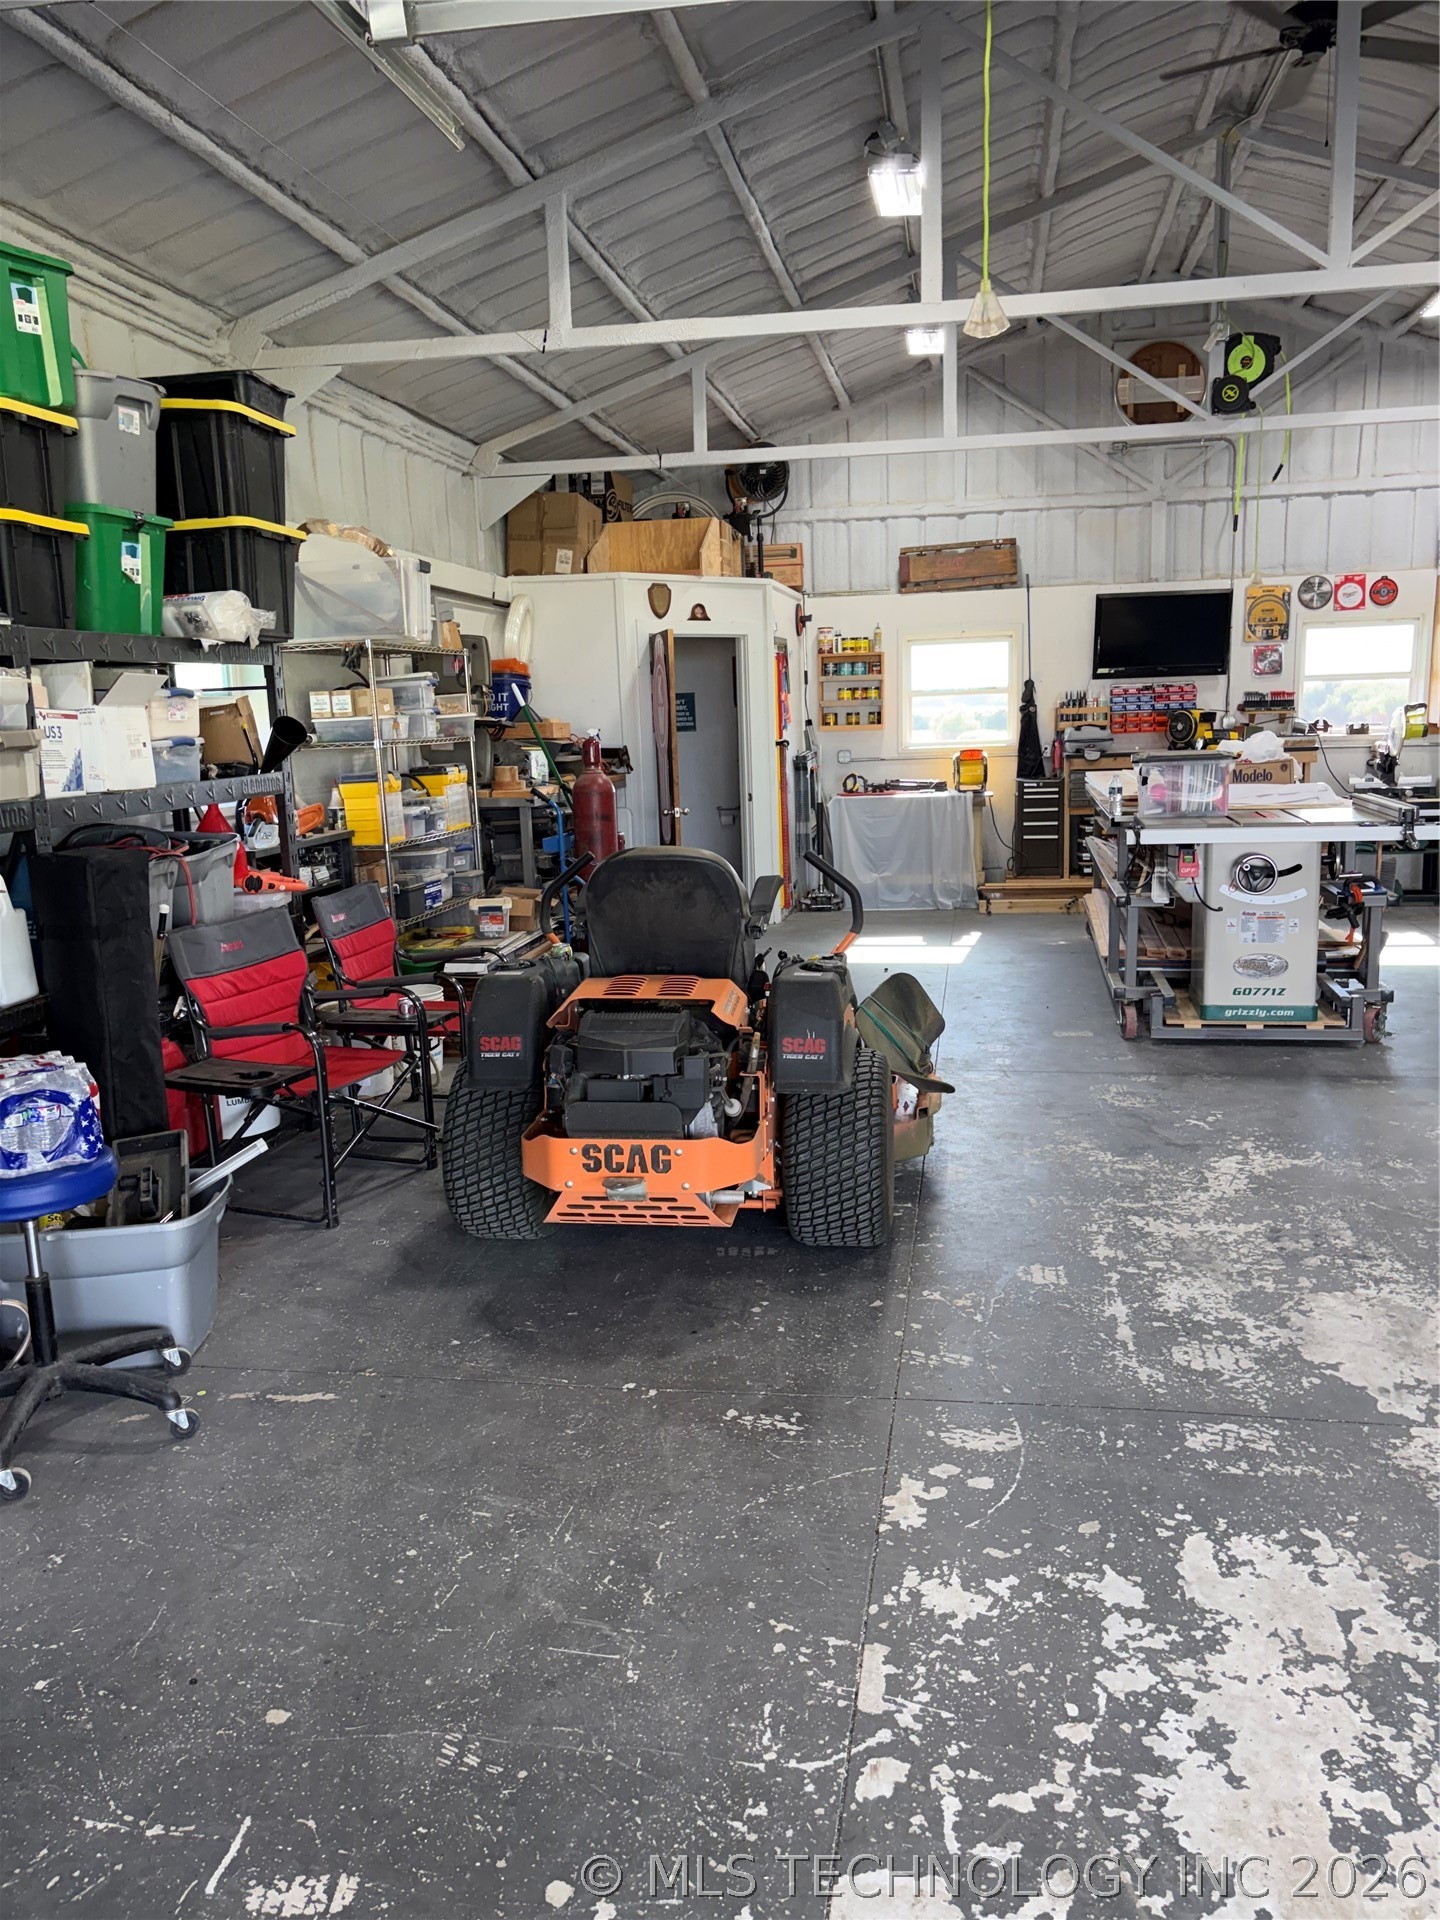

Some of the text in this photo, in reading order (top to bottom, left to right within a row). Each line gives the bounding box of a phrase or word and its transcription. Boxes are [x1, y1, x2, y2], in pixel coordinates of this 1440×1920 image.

[488, 703, 509, 711] IGHT
[1232, 769, 1273, 783] Modelo
[242, 776, 282, 794] GLADIATOR
[1224, 1008, 1295, 1018] grizzly.com
[480, 1036, 522, 1051] SCAG
[782, 1037, 826, 1053] SCAG
[581, 1143, 672, 1174] SCAG
